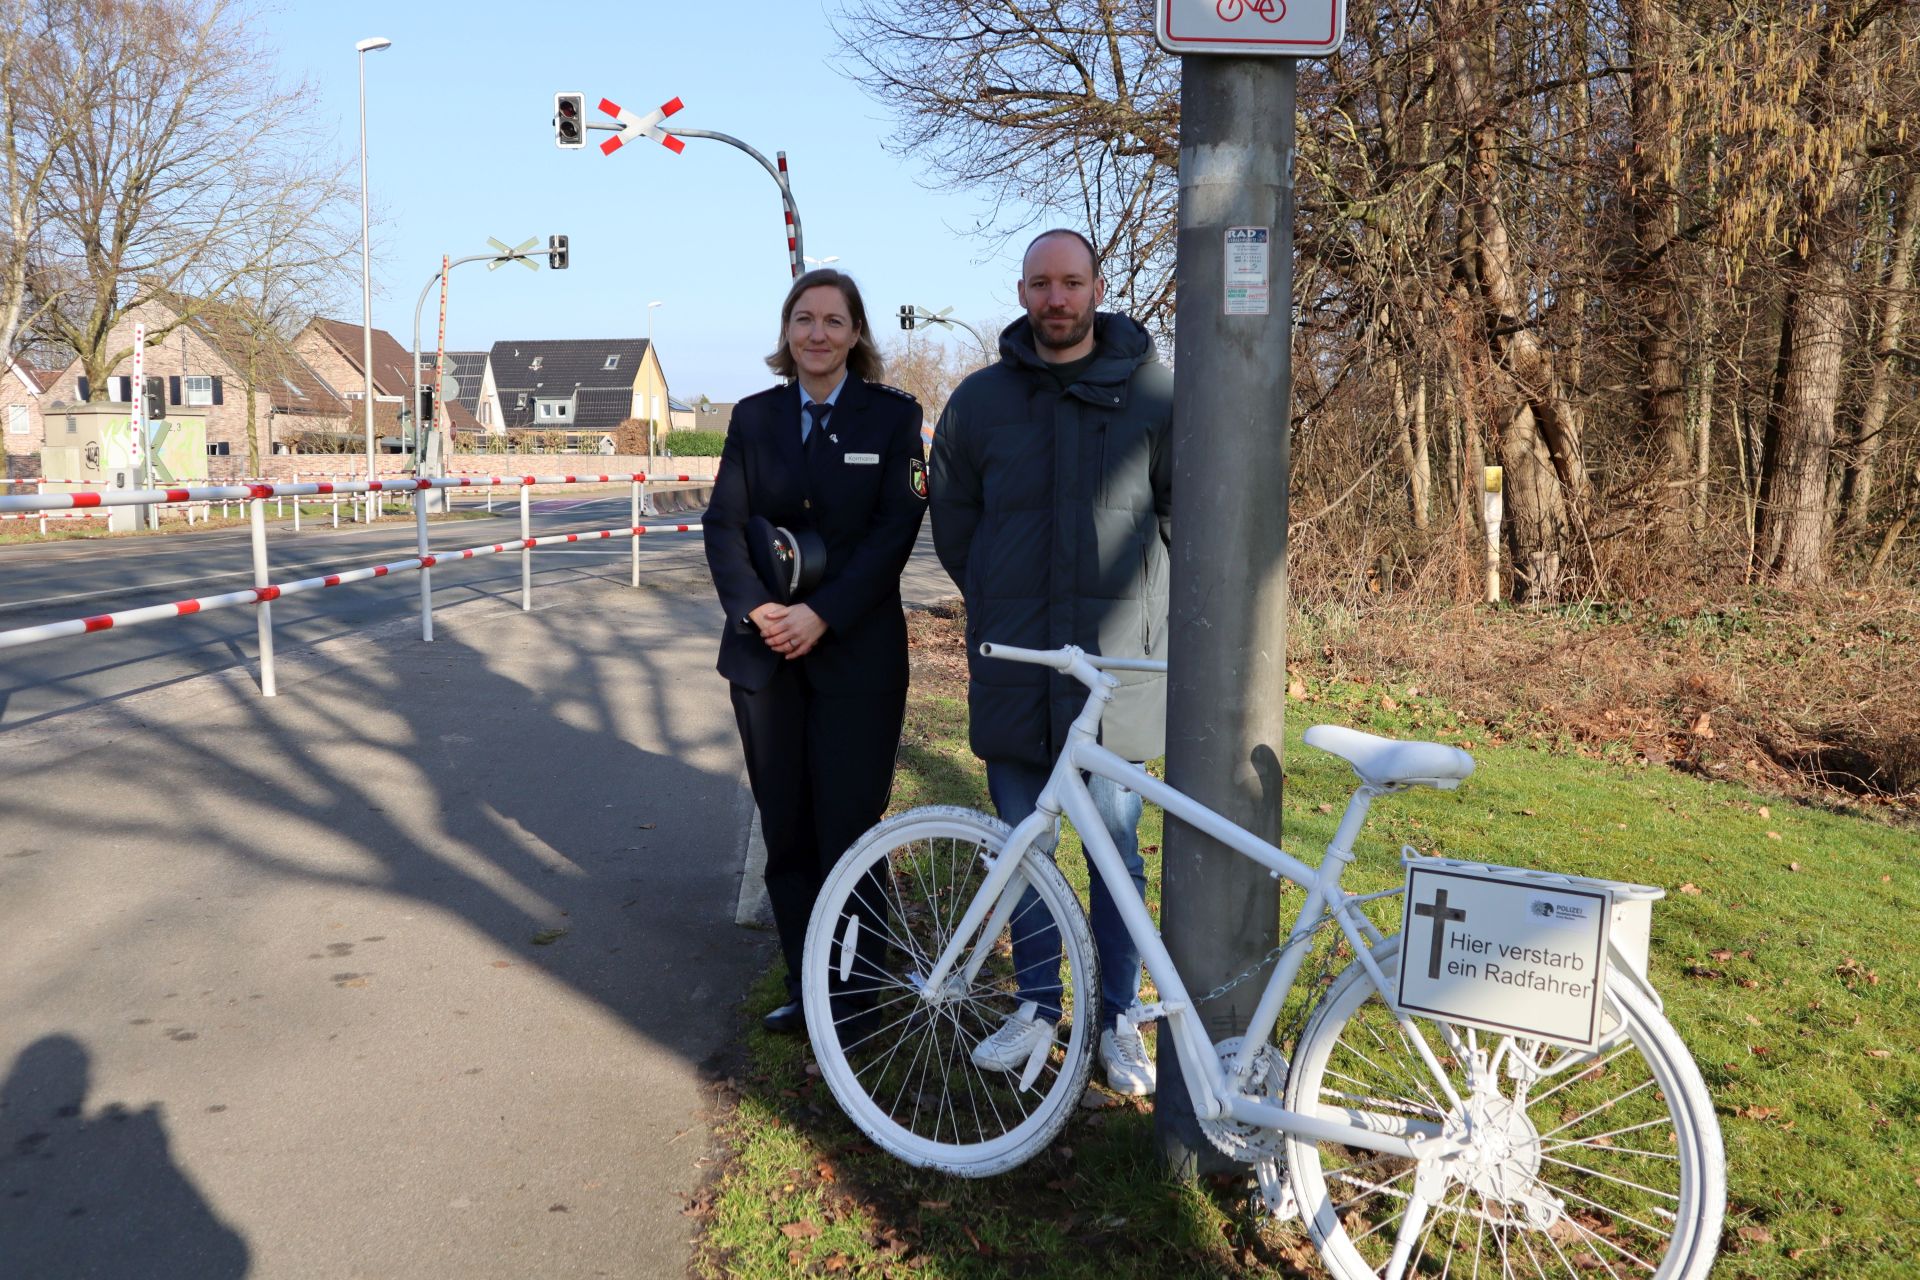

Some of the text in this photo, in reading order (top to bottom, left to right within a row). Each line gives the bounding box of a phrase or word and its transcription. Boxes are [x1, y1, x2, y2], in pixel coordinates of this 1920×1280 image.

[1228, 230, 1257, 238] RAD
[1556, 904, 1583, 915] POLIZEI
[1450, 931, 1584, 972] Hier verstarb
[1447, 958, 1591, 999] ein Radfahrer
